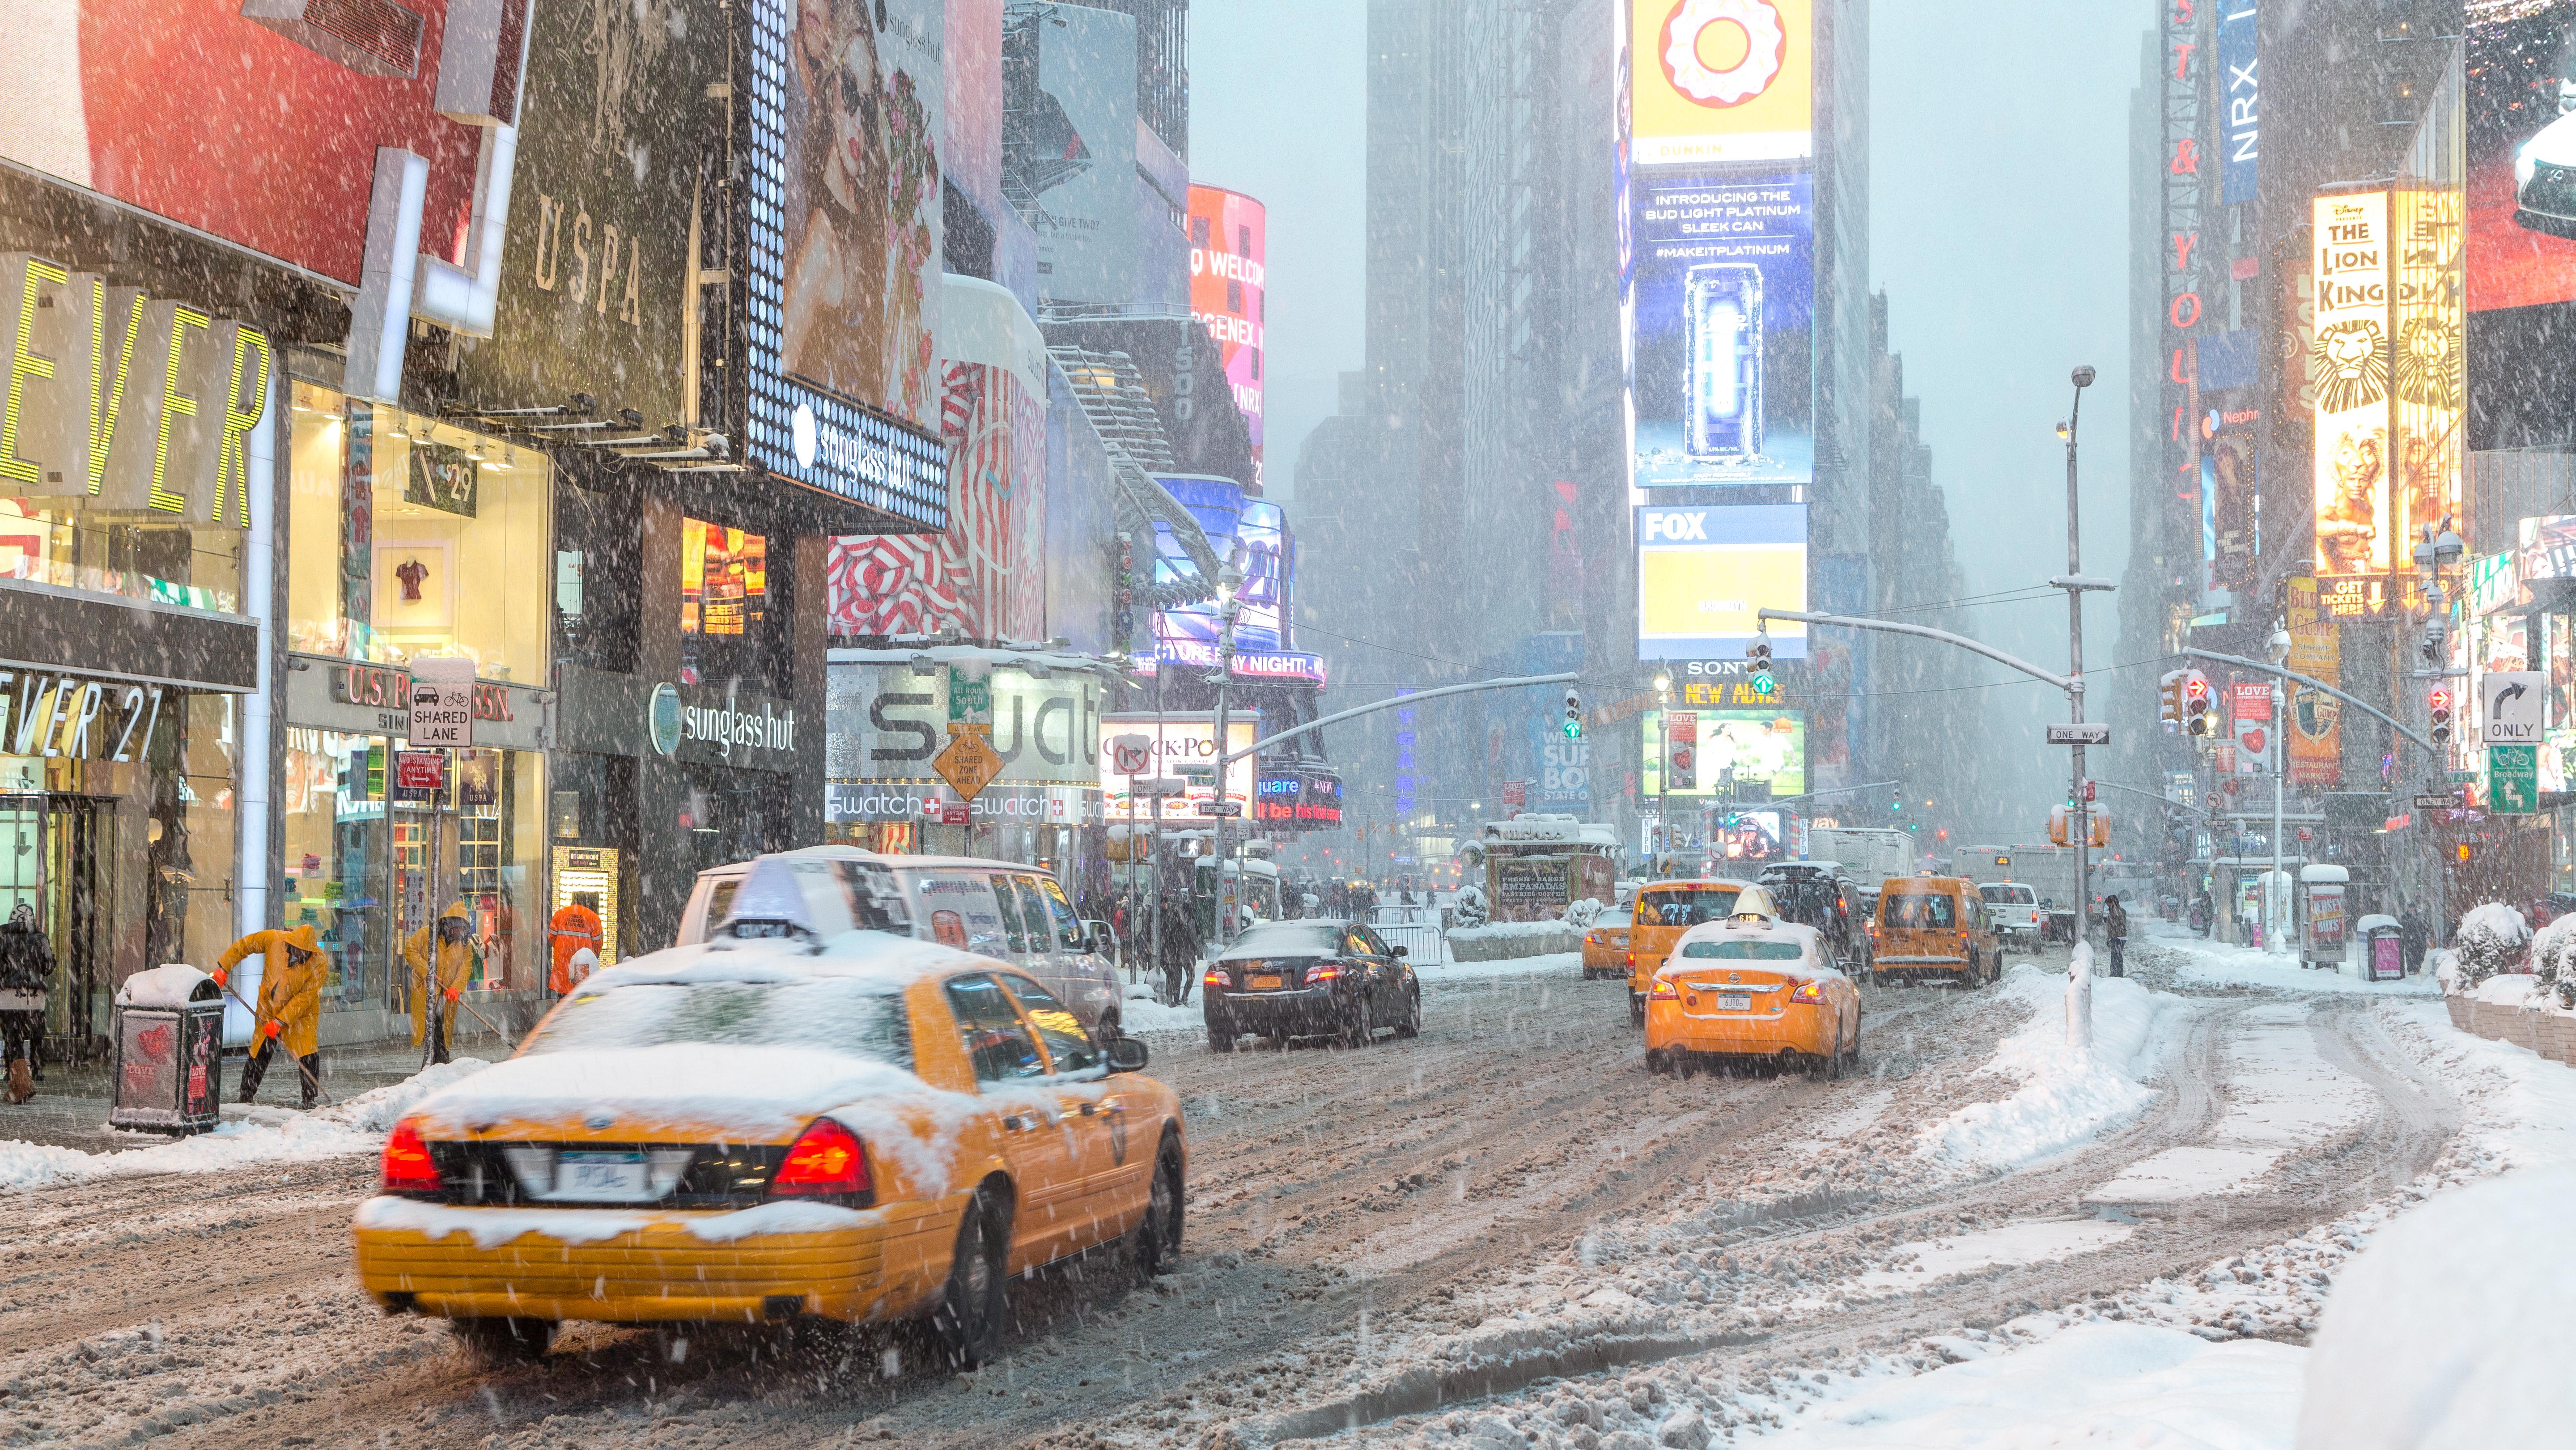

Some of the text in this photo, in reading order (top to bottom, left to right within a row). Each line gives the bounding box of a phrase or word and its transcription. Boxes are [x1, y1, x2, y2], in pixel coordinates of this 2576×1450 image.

[889, 14, 941, 65] sunglass hut
[1656, 191, 1790, 205] INTRODUCING THE
[1646, 205, 1800, 220] BUD LIGHT PLATINUM
[2331, 205, 2364, 215] Disney
[1682, 221, 1763, 233] SLEEK CAN
[2329, 223, 2370, 242] THE
[1656, 245, 1789, 258] #MAKEITPLATINUM
[535, 194, 641, 326] USPA
[2323, 248, 2377, 275] LION
[2319, 281, 2384, 312] KING
[0, 260, 270, 528] EVER
[821, 423, 911, 490] sunglass hut
[1646, 512, 1707, 541] FOX
[2336, 581, 2364, 594] GET
[2291, 586, 2317, 609] BUB
[2321, 594, 2364, 603] TICKETS
[2332, 604, 2364, 615] HERE
[2297, 643, 2331, 652] SHRIMP
[2293, 653, 2335, 661] COMPANY
[1250, 656, 1306, 673] NIGHT!
[348, 666, 388, 707] U.S.
[2237, 686, 2270, 695] LOVE
[955, 696, 983, 704] South
[1685, 684, 1723, 704] NEW
[414, 711, 467, 723] SHARED
[2317, 706, 2337, 721] GUMP
[113, 687, 162, 763] 21
[378, 713, 408, 730] SIN
[686, 697, 794, 757] sunglass hut
[424, 728, 458, 741] LANE
[2056, 730, 2100, 740] ONE WAY
[2492, 724, 2534, 737] ONLY
[402, 756, 440, 766] NO STANDING
[2291, 761, 2339, 769] RESTAURANT
[406, 766, 435, 774] ANYTIME
[2494, 771, 2534, 779] Broadway
[956, 776, 980, 784] AHEAD
[1188, 776, 1208, 786] W 45
[2448, 773, 2470, 782] W 45
[1137, 784, 1153, 793] ONE
[1545, 791, 1576, 800] STATE
[828, 793, 922, 815] swatch
[970, 794, 1051, 816] swatch
[1269, 802, 1293, 818] be
[1296, 803, 1311, 818] his
[1739, 914, 1758, 923] 6J10
[191, 1067, 206, 1076] LOVE
